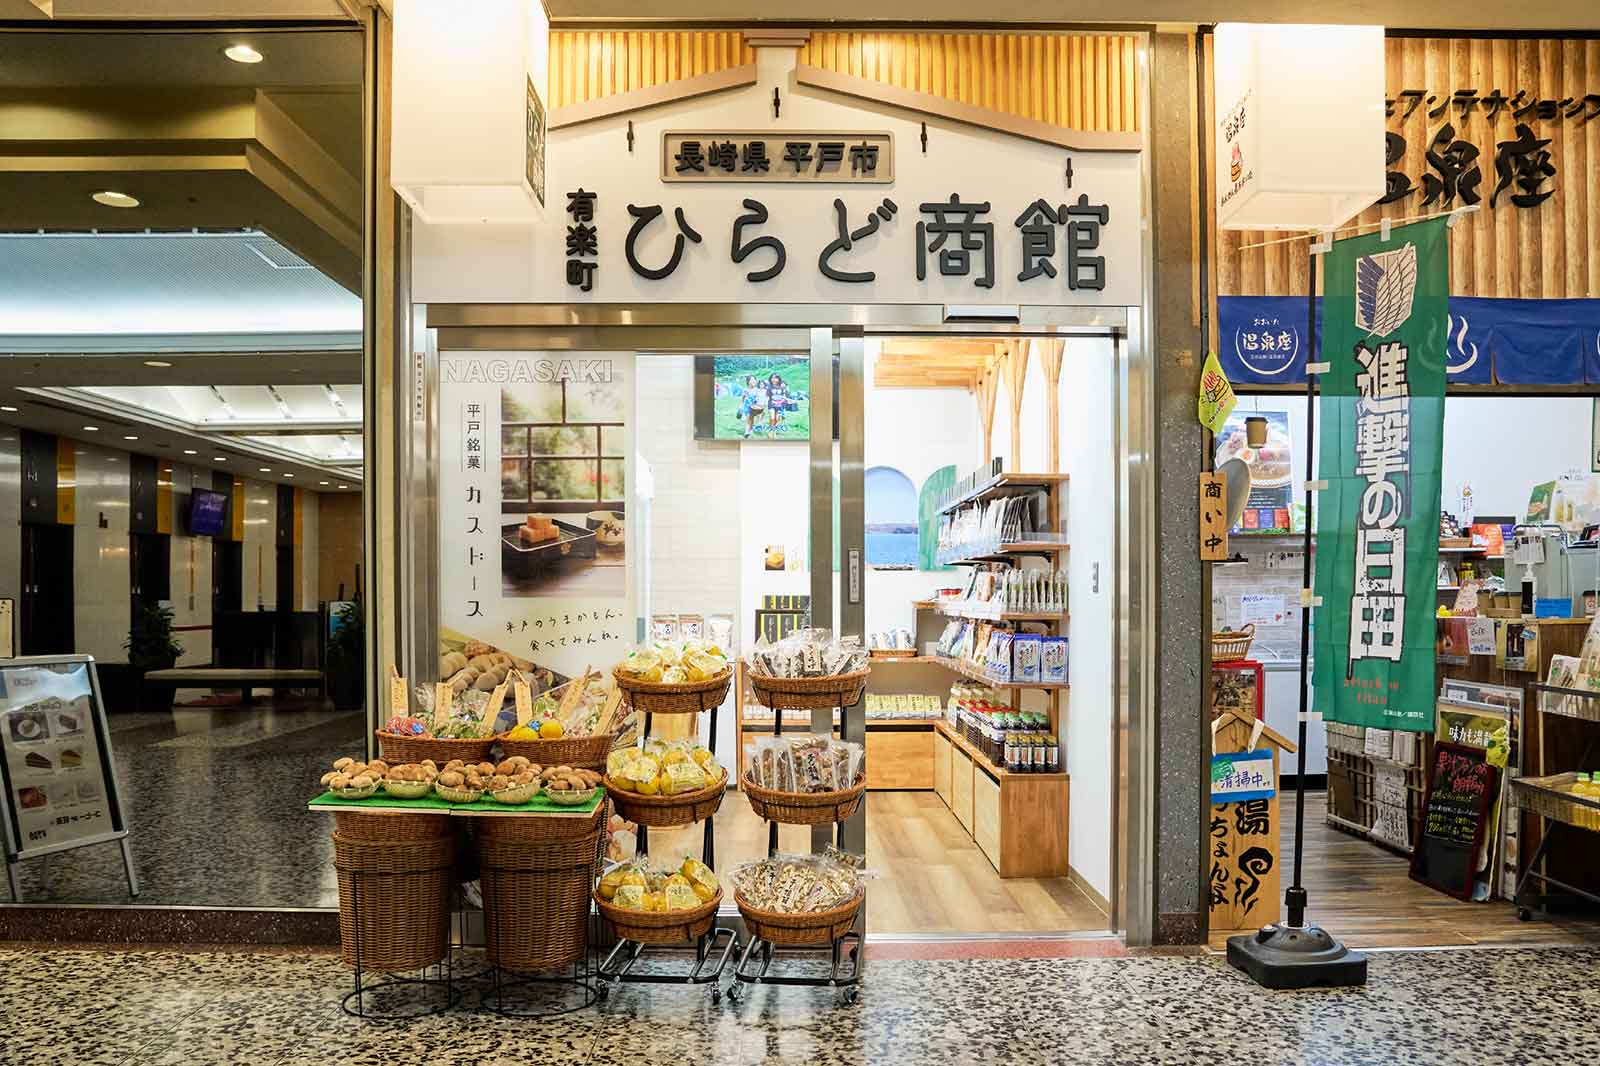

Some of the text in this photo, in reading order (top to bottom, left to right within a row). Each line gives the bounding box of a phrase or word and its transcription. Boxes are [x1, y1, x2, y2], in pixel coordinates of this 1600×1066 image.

[674, 140, 880, 173] 長崎県 平戸市
[566, 187, 598, 293] 有楽町
[625, 193, 1110, 291] ひらど商館
[440, 359, 613, 384] NAGASAKI
[1242, 331, 1293, 351] 温泉座
[465, 403, 484, 617] 平戸銘菓 カスドース
[1204, 481, 1223, 553] 商い中
[1352, 341, 1410, 662] 進撃の日田
